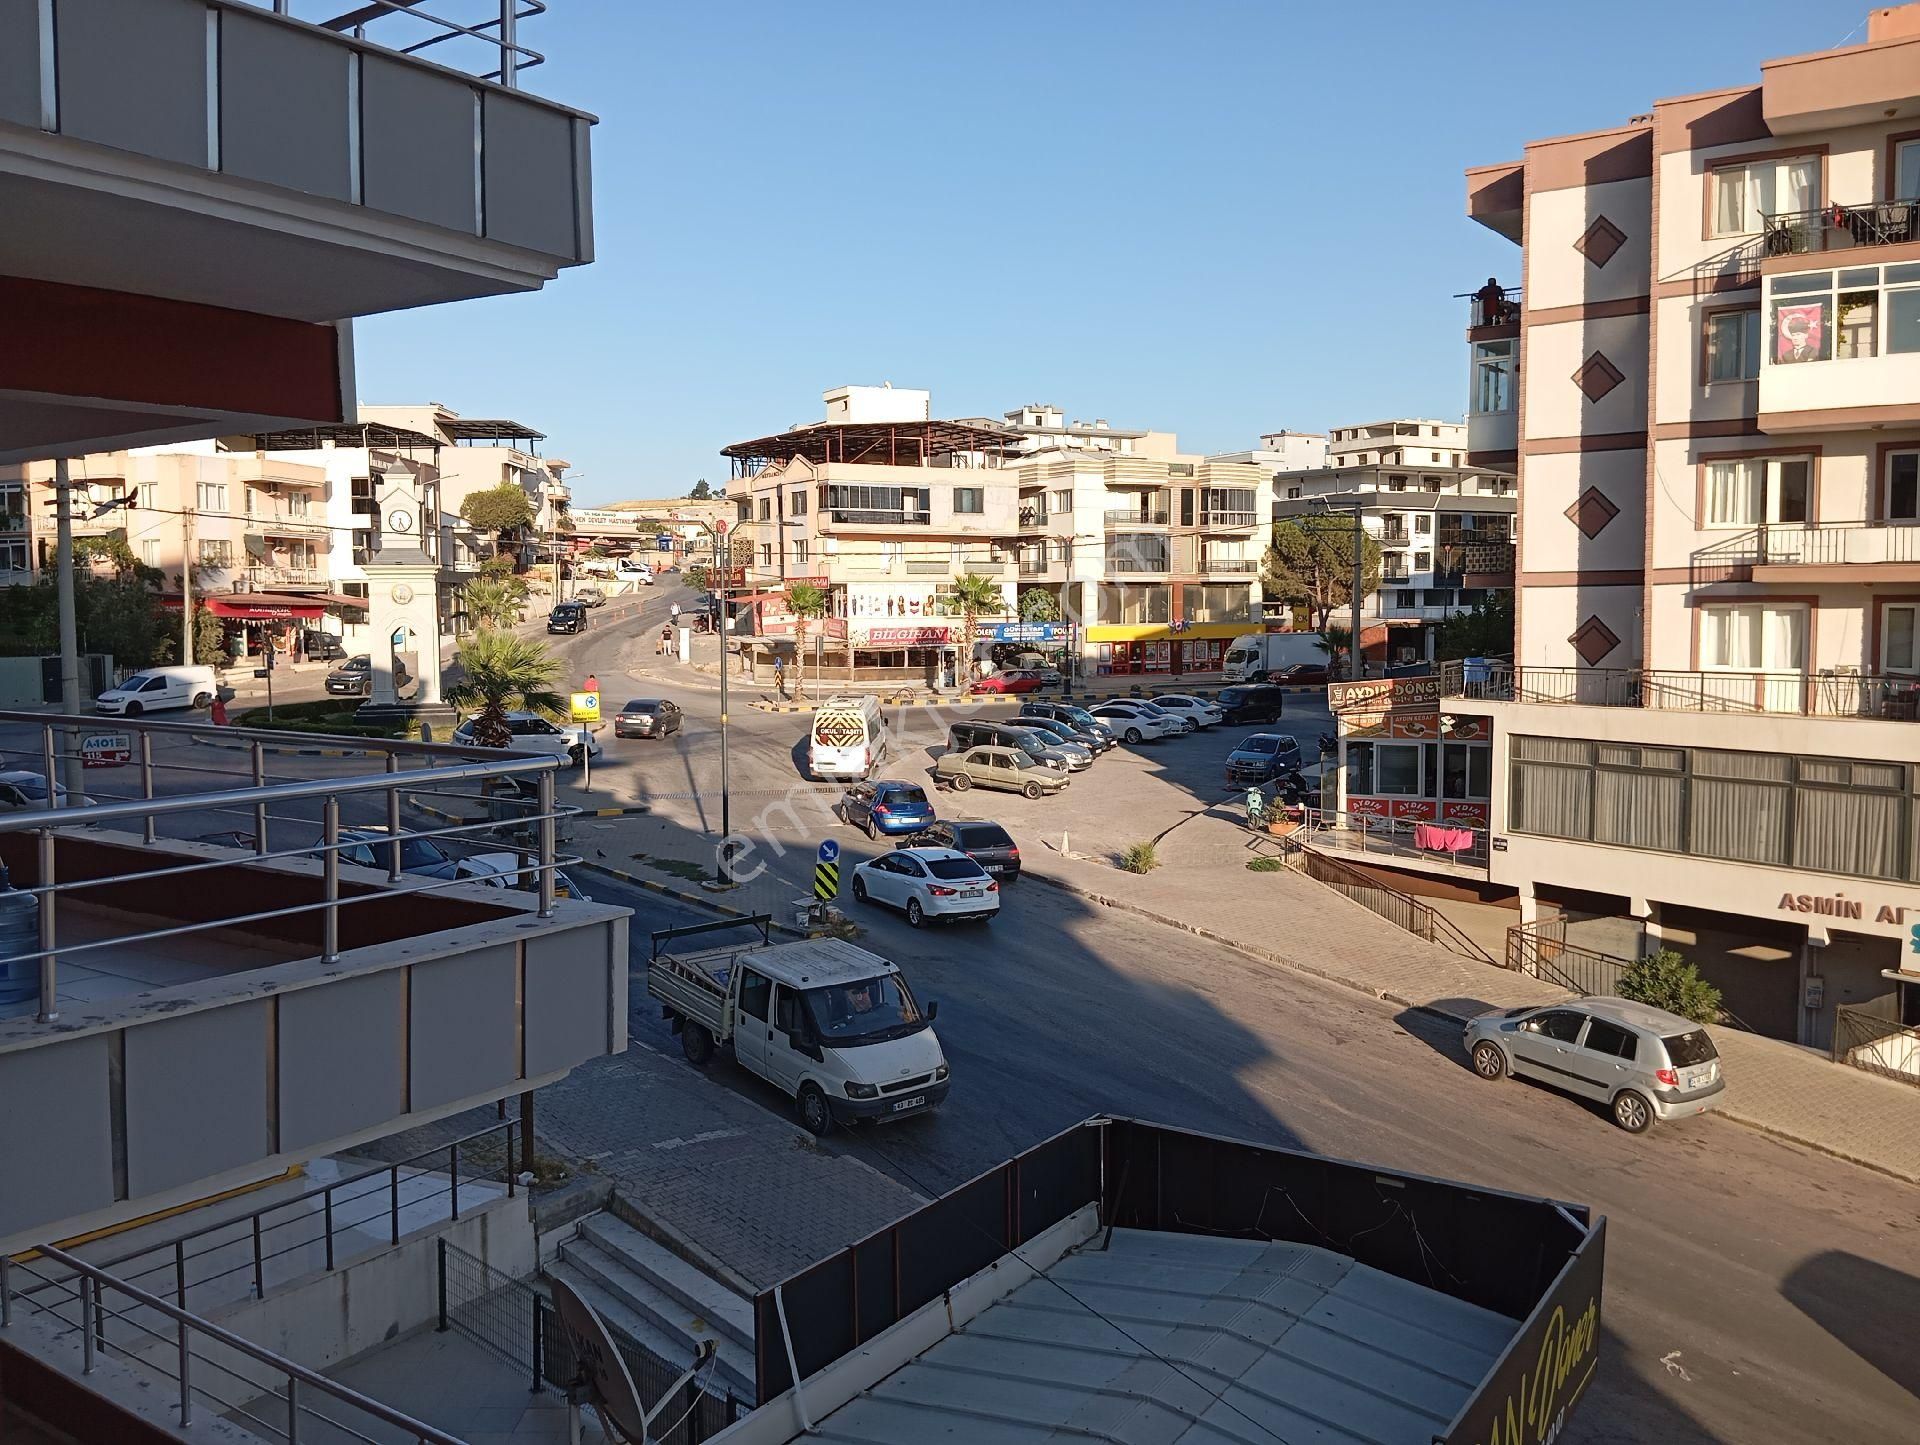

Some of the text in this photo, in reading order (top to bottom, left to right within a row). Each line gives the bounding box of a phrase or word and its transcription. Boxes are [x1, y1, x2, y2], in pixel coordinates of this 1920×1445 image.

[1346, 685, 1390, 700] AYDIN
[1353, 800, 1382, 810] AYDIN
[1400, 801, 1430, 812] AYDIN
[1450, 804, 1481, 815] AYDIN
[1778, 892, 1862, 920] ASMİN
